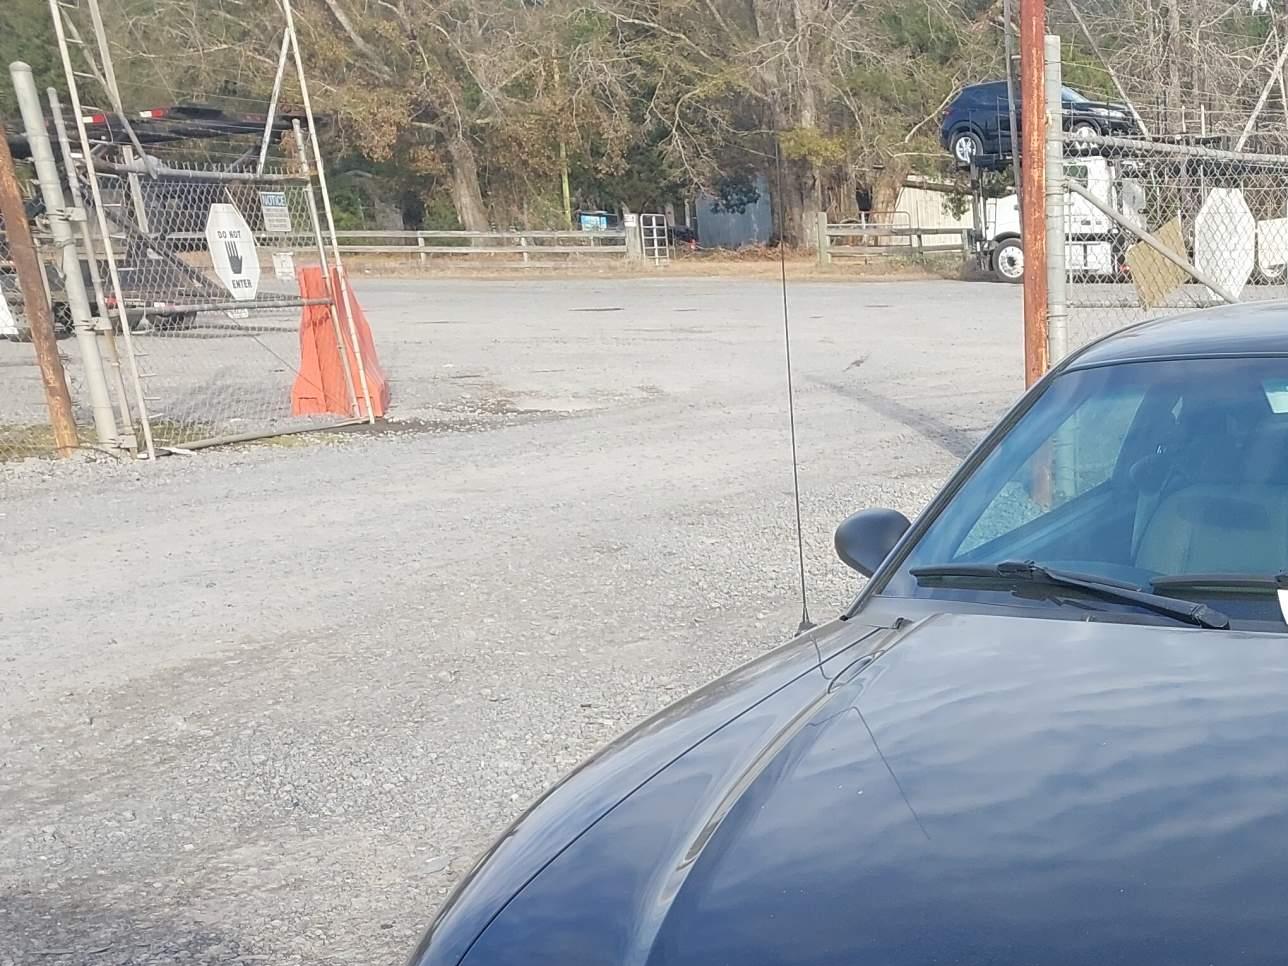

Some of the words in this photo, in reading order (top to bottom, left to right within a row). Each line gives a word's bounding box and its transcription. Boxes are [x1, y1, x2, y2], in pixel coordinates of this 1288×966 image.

[261, 194, 286, 206] NOTICE
[217, 230, 228, 239] DO
[229, 230, 241, 239] NOT
[231, 279, 253, 289] ENTER
